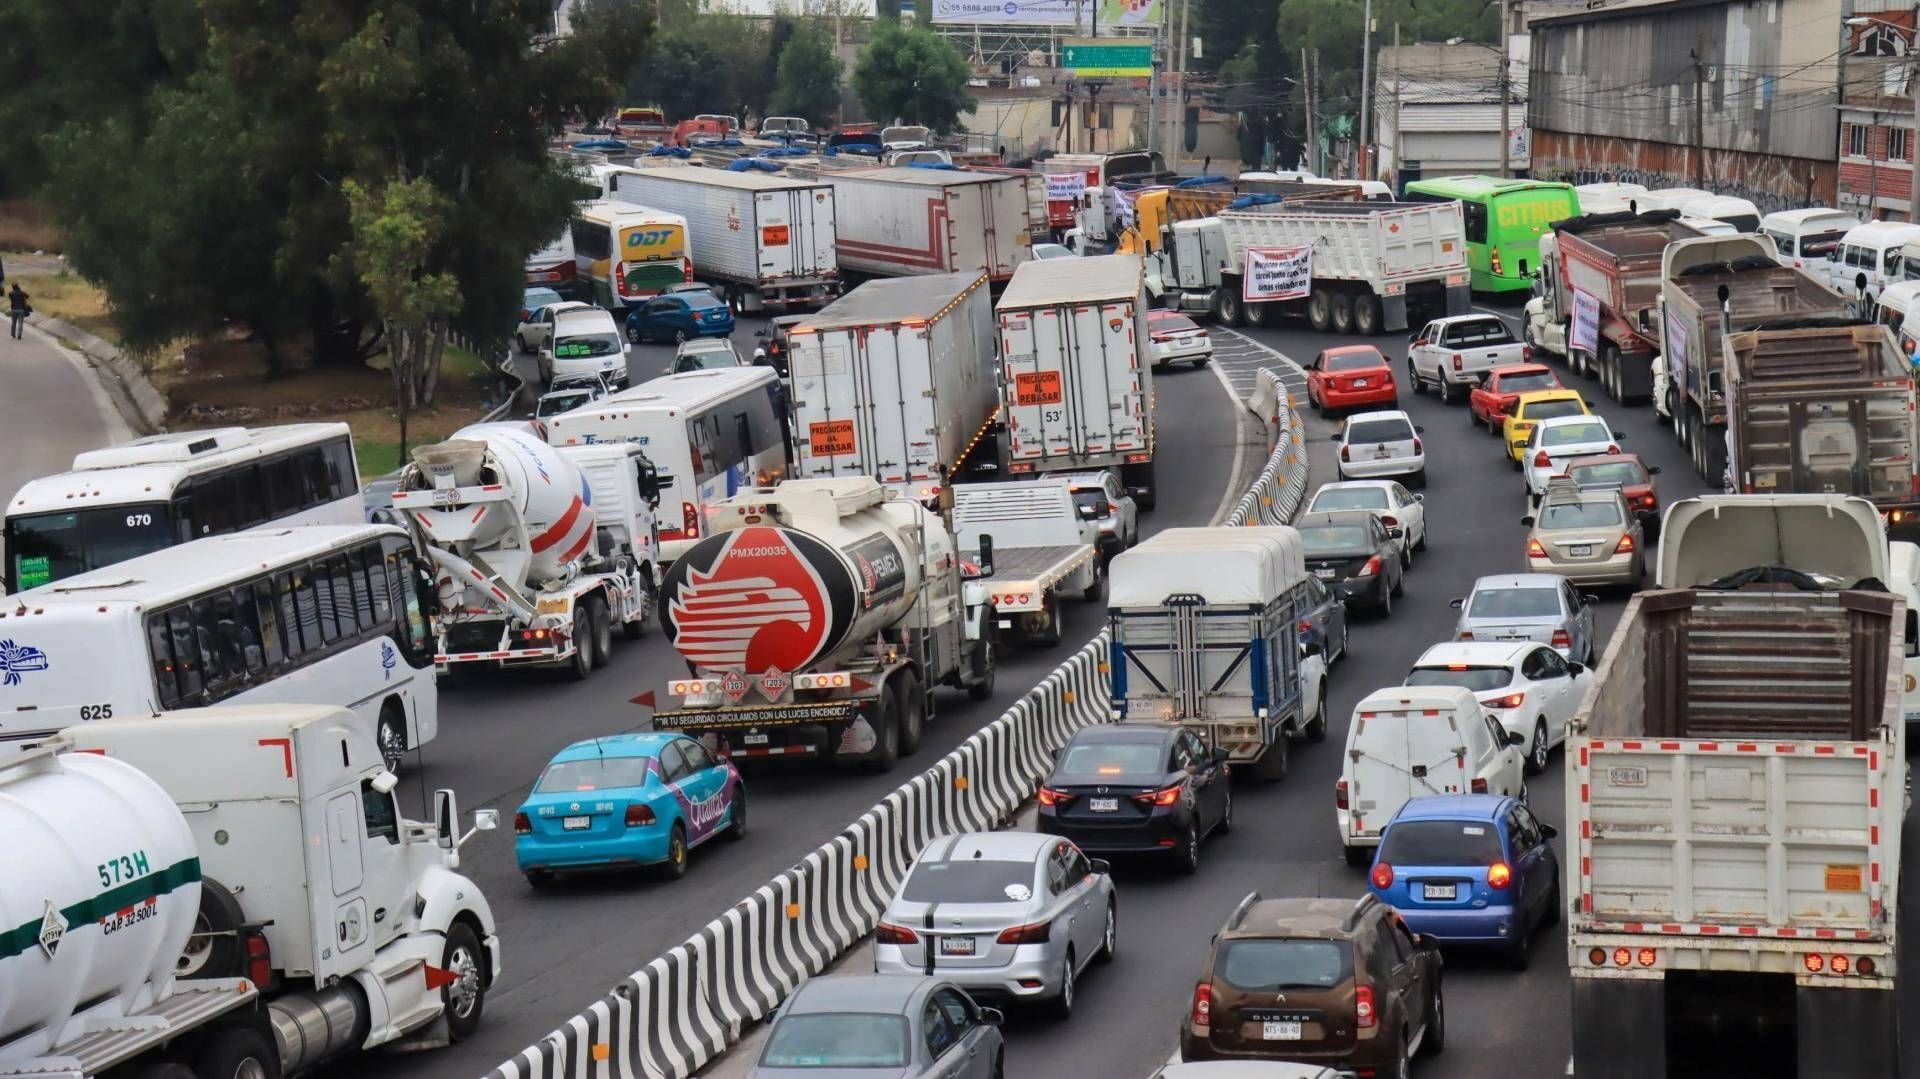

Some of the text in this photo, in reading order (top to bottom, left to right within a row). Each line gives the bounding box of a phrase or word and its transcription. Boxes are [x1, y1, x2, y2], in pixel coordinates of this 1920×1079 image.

[1497, 199, 1569, 227] CITRUS
[1018, 374, 1057, 384] PRECAUCION
[1020, 393, 1059, 403] REBASAR
[811, 424, 852, 434] PRECAUCION
[813, 444, 852, 453] REBASAR
[126, 514, 151, 527] 670
[729, 545, 787, 558] PMX20035
[871, 552, 899, 577] PEMEX
[726, 681, 743, 690] 1203
[766, 679, 783, 688] 1203
[80, 704, 112, 720] 625
[669, 717, 679, 725] TU
[679, 714, 716, 725] SEGURIDAD
[716, 711, 758, 723] CIRCULAMOS
[758, 711, 774, 721] CON
[773, 710, 788, 720] LAS
[788, 708, 810, 719] LUCES
[98, 850, 150, 887] 573H
